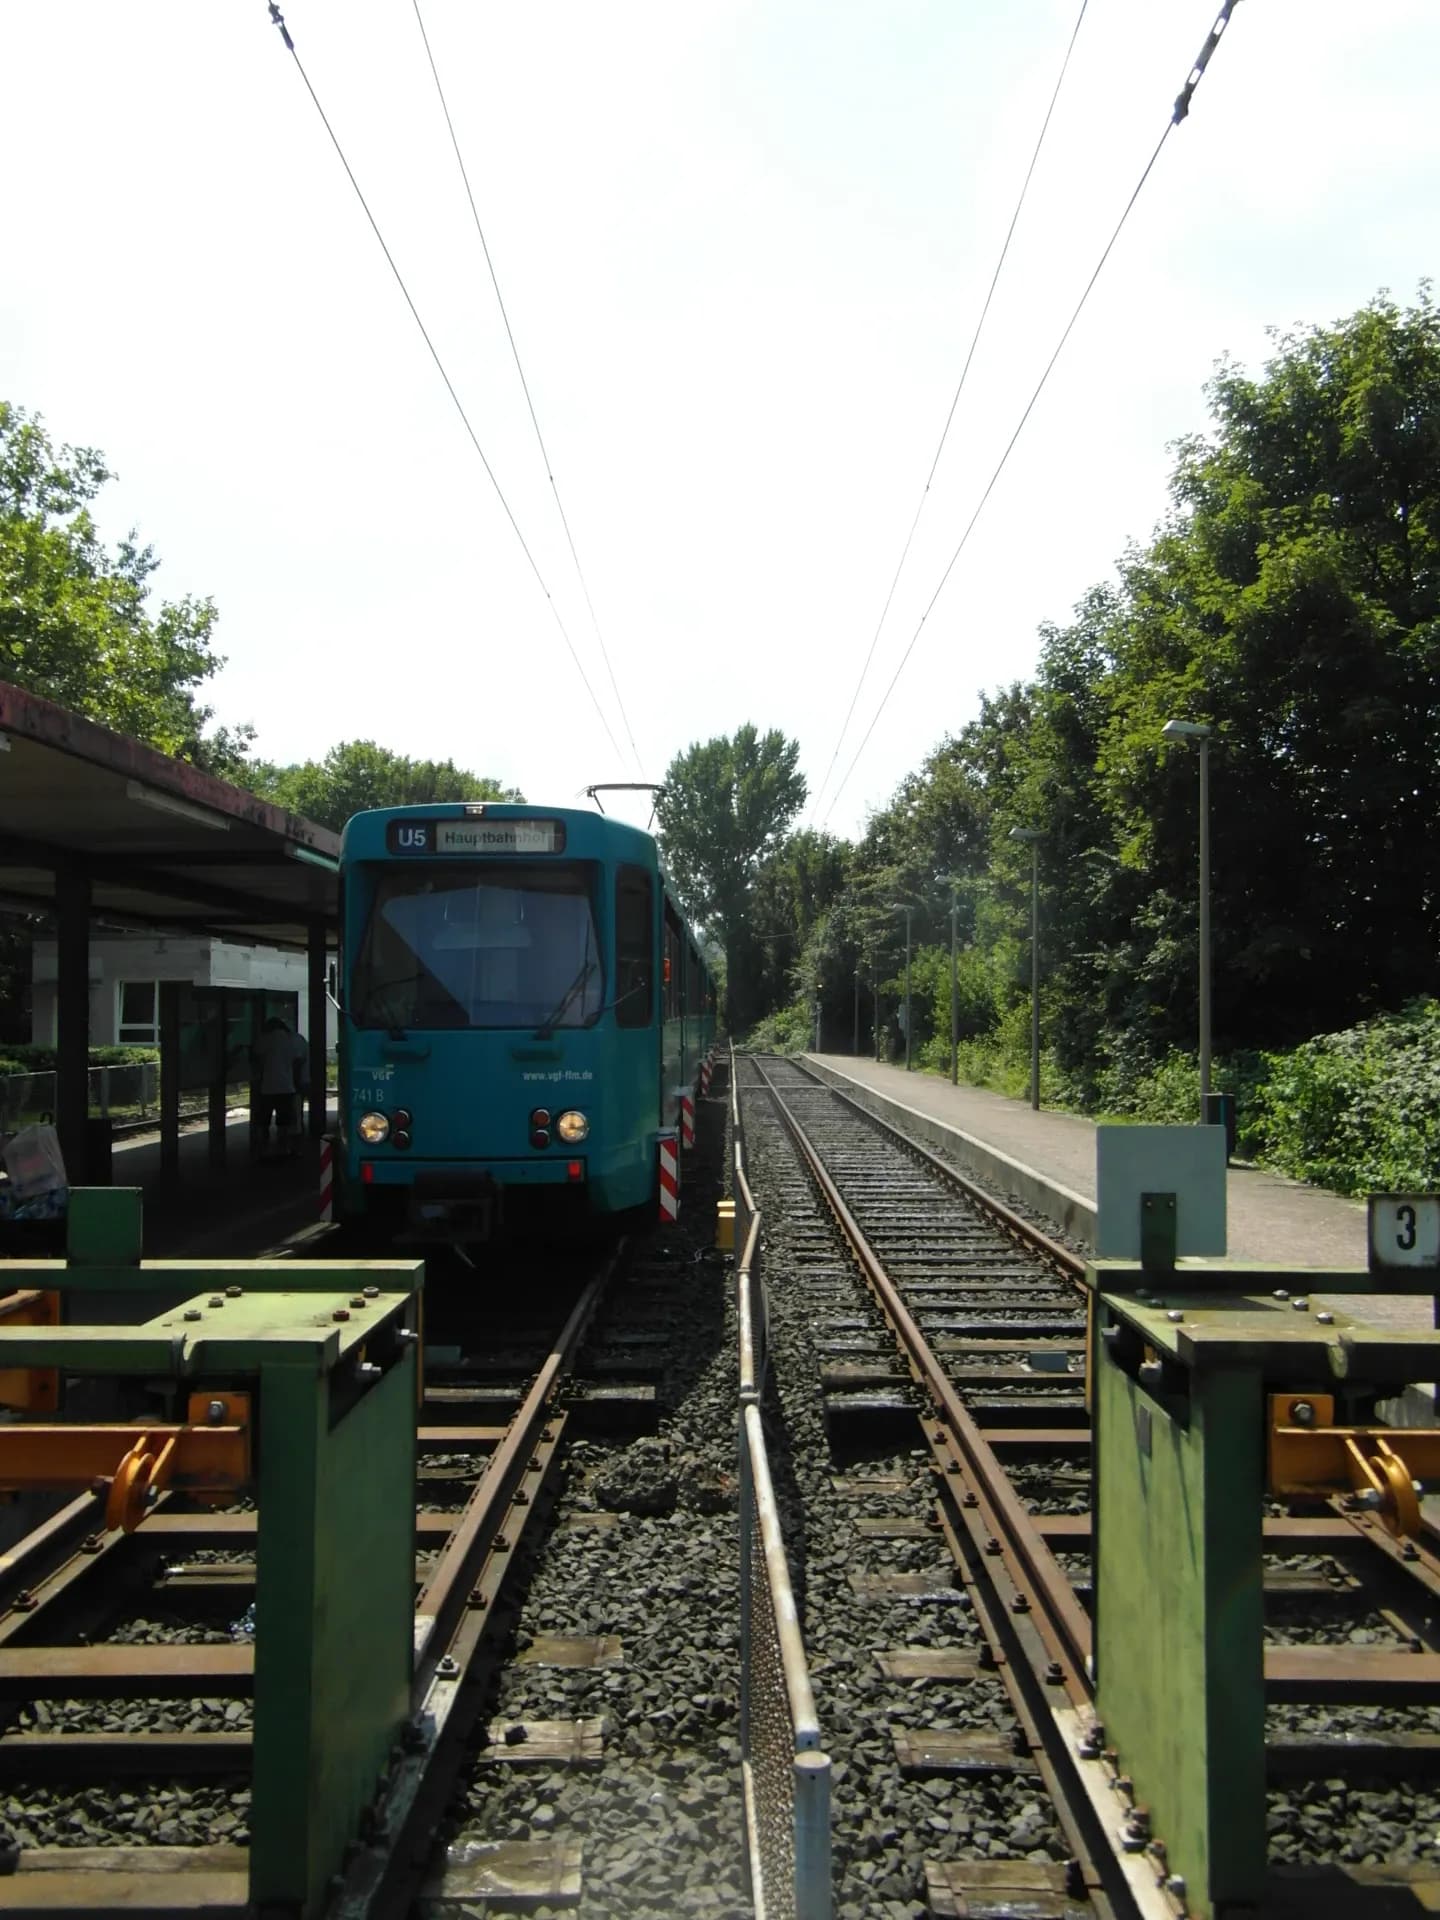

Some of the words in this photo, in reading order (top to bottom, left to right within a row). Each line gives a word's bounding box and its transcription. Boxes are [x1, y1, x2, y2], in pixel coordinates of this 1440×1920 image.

[398, 828, 426, 847] U5
[445, 830, 546, 847] Hauptbahnhof
[1396, 1205, 1417, 1251] 3
